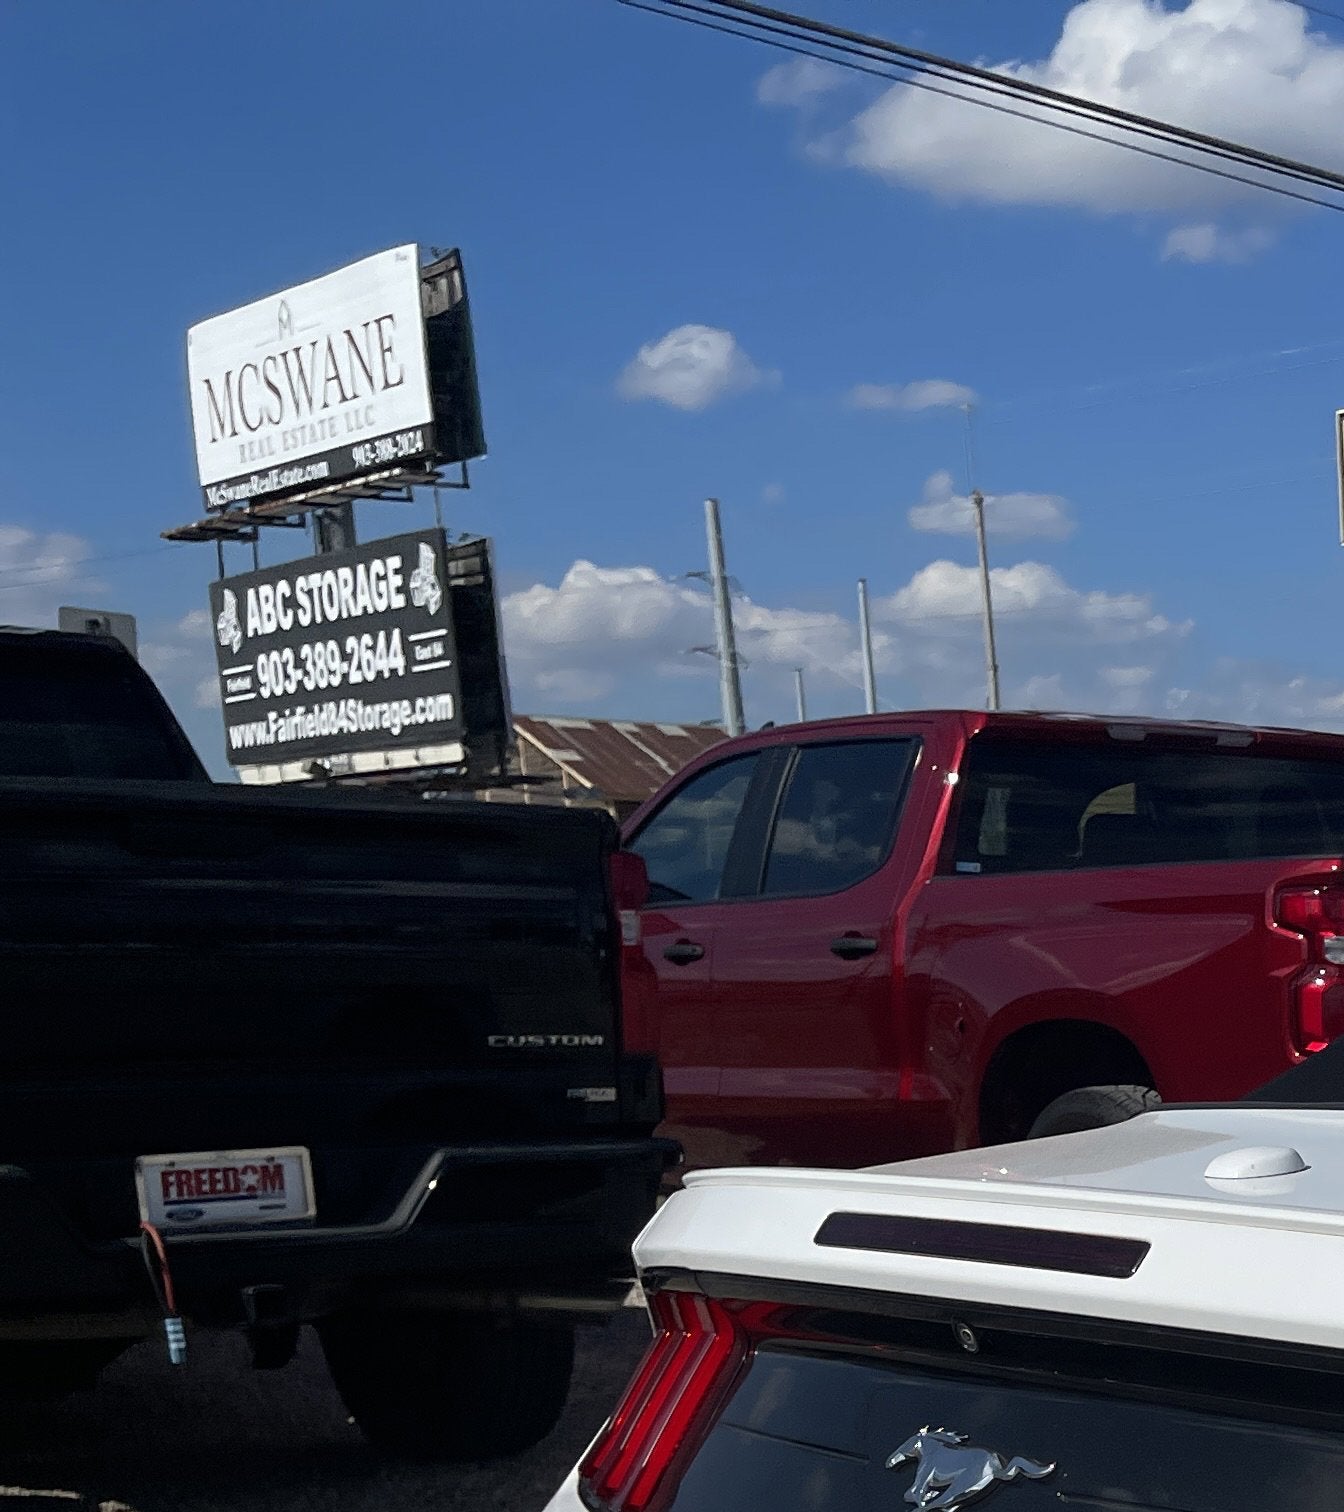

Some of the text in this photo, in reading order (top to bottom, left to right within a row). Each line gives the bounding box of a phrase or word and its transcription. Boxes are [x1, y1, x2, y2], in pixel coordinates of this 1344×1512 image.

[202, 313, 404, 443] MCSWANE
[239, 404, 376, 463] REAL ESTATE LLC
[246, 555, 407, 638] ABC STORAGE
[256, 628, 406, 699] 903-389-2644
[487, 1034, 604, 1048] CUSTOM
[161, 1163, 286, 1200] FREEDOM
